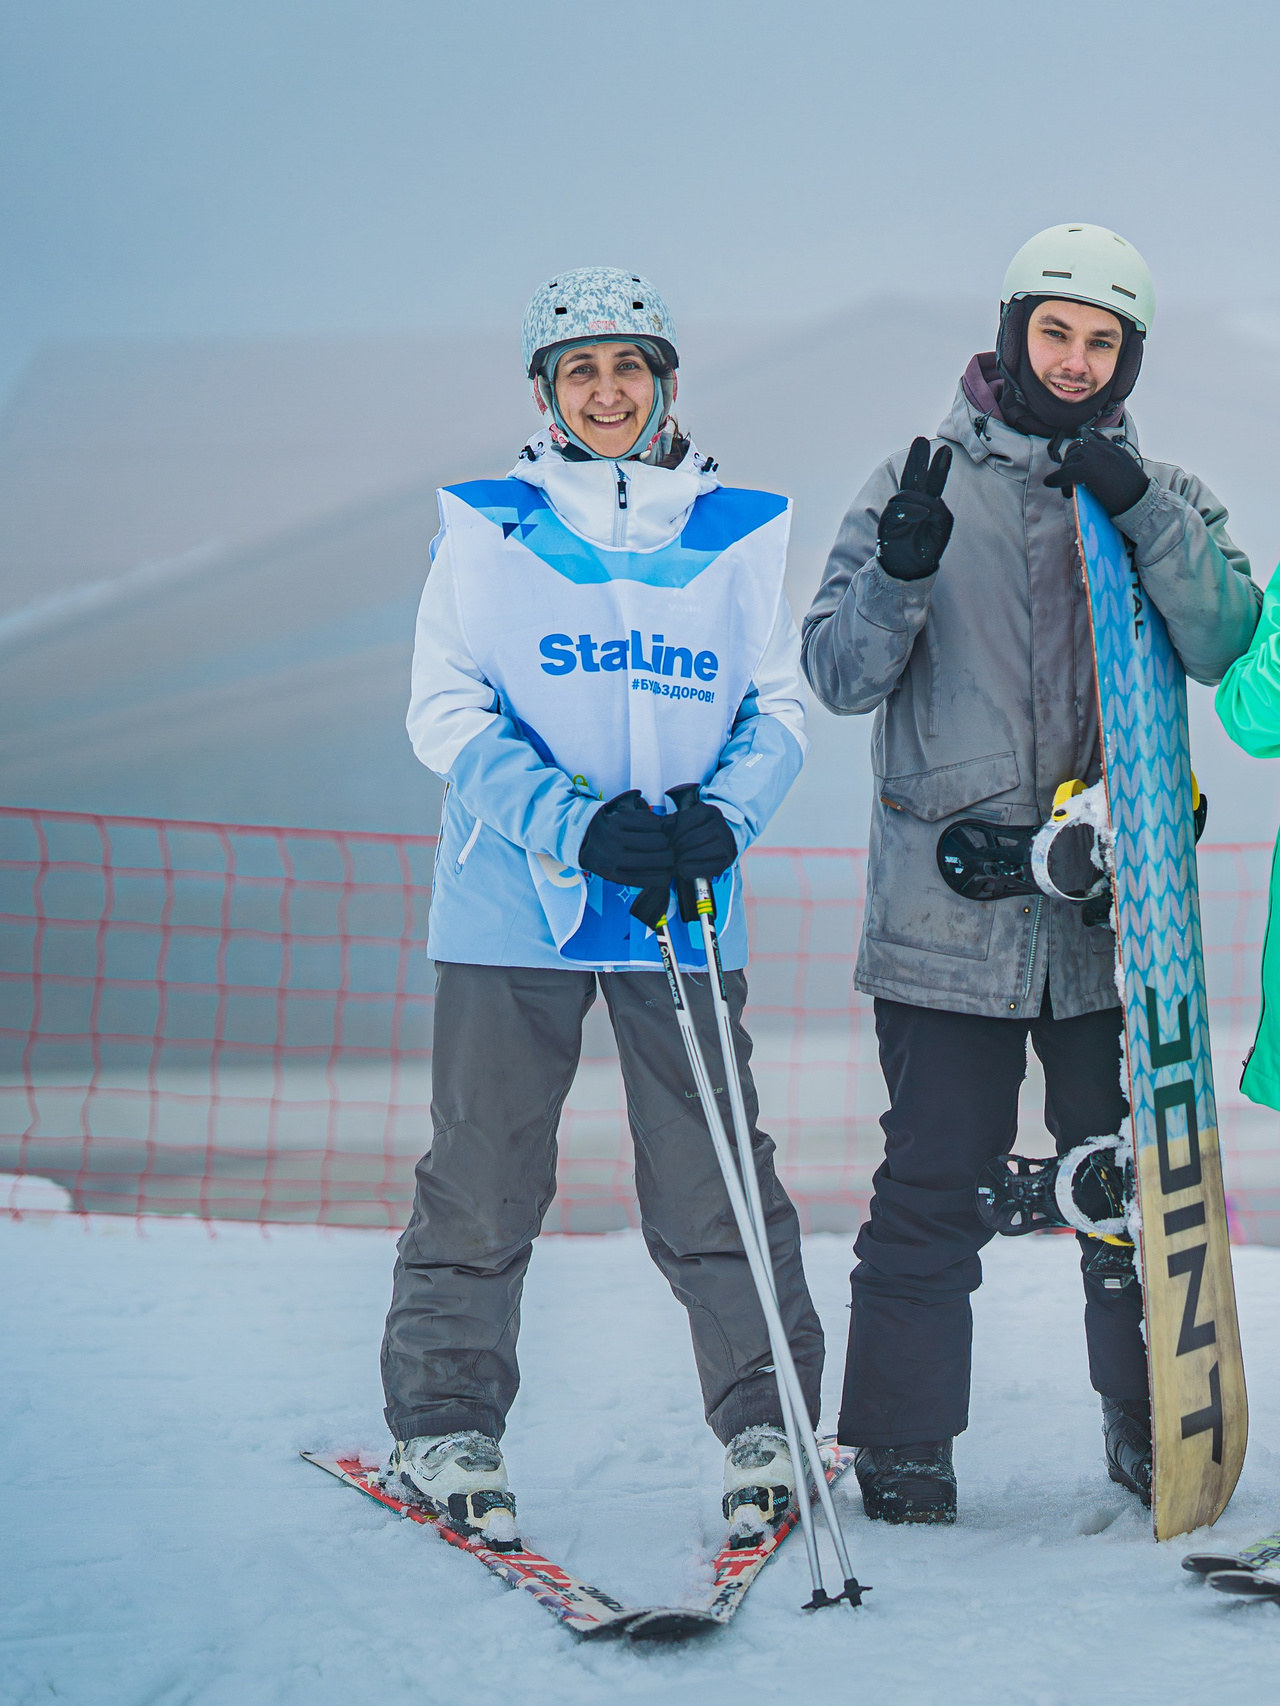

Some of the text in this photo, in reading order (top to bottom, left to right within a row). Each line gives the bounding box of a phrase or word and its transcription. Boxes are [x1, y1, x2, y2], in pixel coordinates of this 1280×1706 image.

[539, 629, 719, 682] StaLine
[663, 957, 681, 1006] GLISSADE
[1144, 985, 1223, 1465] JOINT
